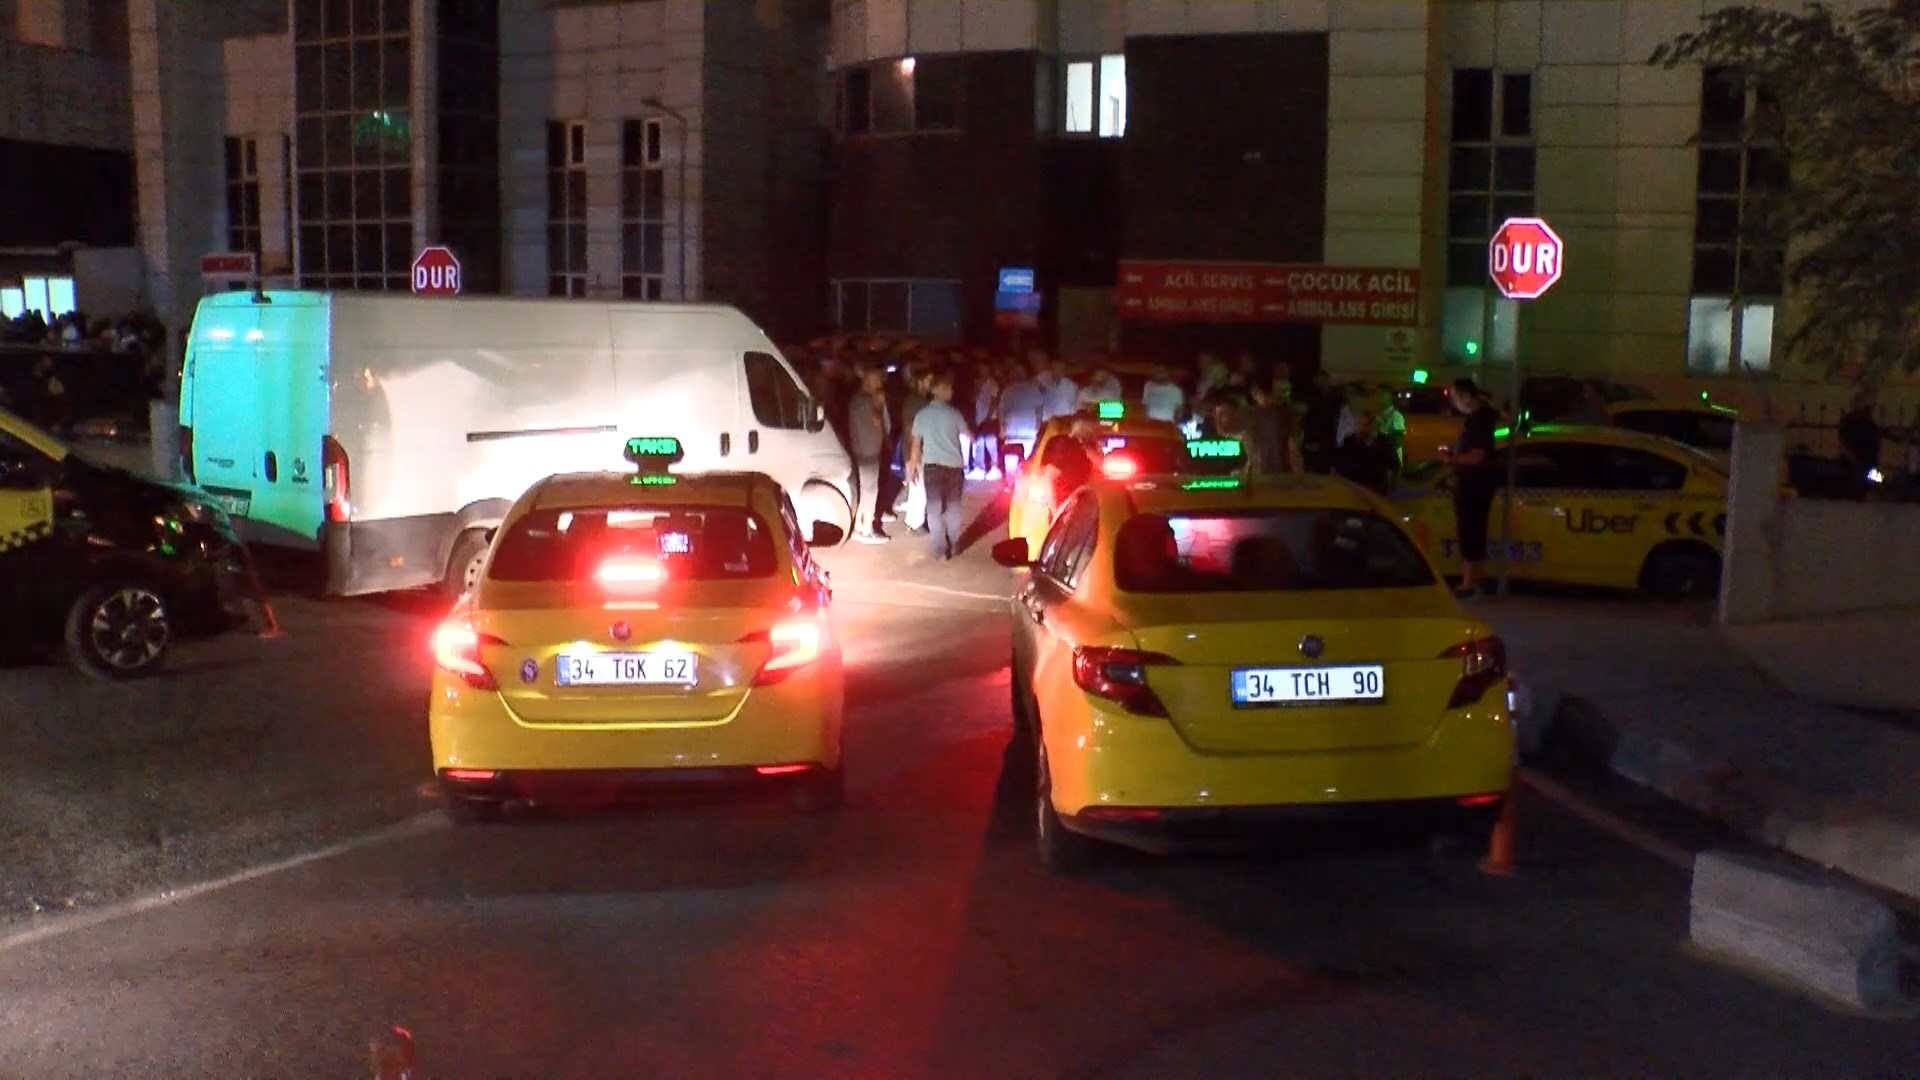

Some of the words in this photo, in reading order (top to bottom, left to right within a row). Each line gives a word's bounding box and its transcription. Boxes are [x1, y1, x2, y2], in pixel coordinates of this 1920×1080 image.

[1494, 243, 1556, 275] DUR
[415, 266, 457, 289] DUR
[1287, 271, 1361, 295] ÇOCUK
[1366, 271, 1416, 293] ACİL
[1564, 508, 1638, 533] Uber
[571, 658, 594, 681] 34
[612, 658, 647, 680] TGK
[664, 658, 688, 680] 62
[1249, 674, 1275, 698] 34
[1291, 671, 1330, 697] TCH
[1353, 670, 1379, 695] 90
